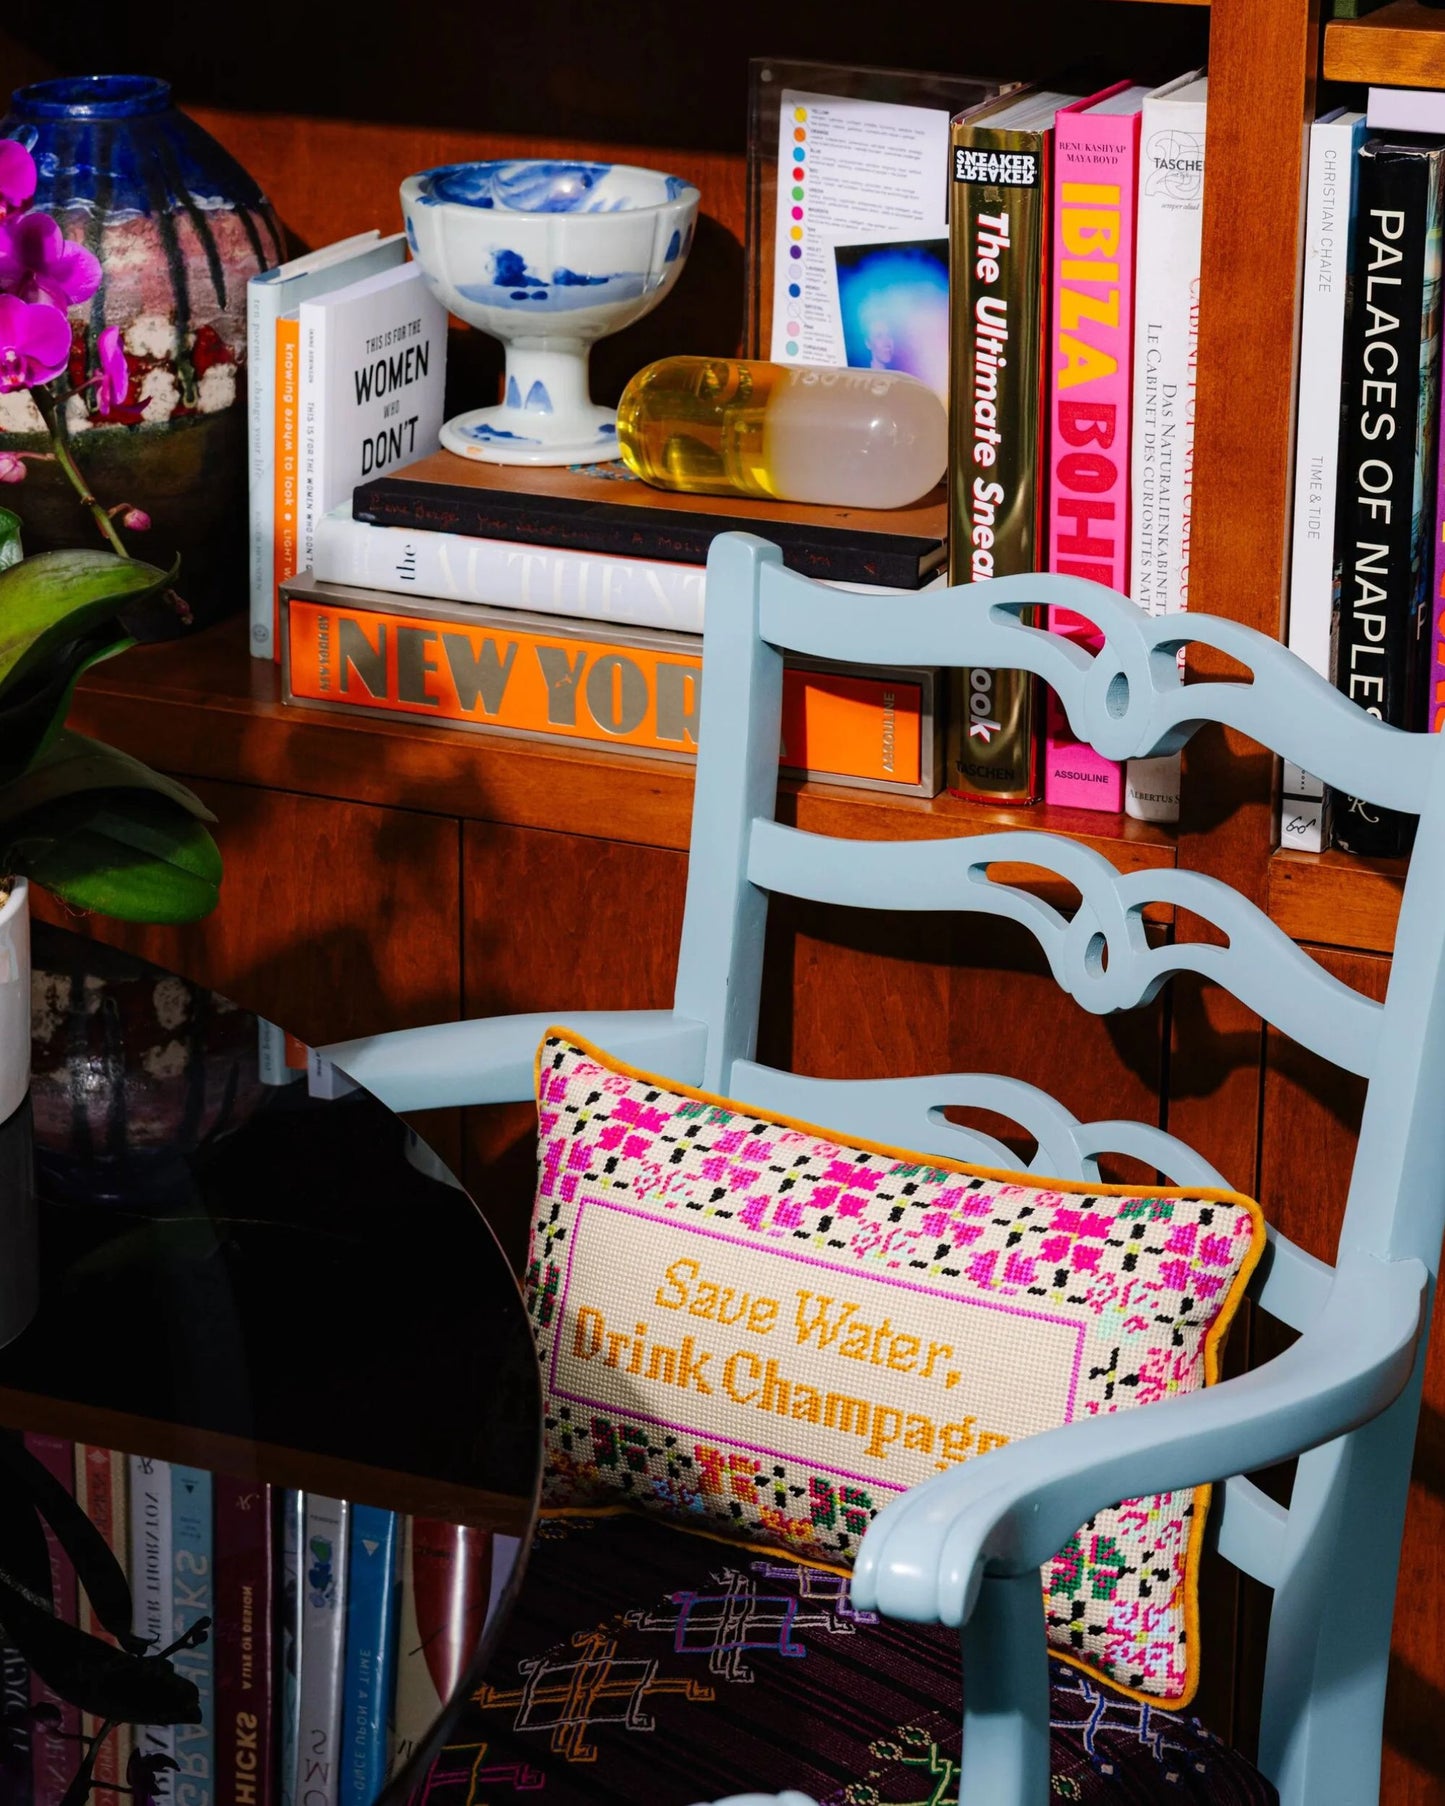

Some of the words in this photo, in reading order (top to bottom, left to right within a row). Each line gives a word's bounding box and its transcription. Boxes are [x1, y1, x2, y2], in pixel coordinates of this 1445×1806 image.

[956, 150, 1035, 168] SNEAKER
[1059, 141, 1083, 151] RENU
[1085, 142, 1127, 154] KASHYAP
[1067, 153, 1092, 163] MAYA
[1093, 155, 1118, 165] BOYD
[1154, 157, 1203, 172] TASCHE
[1322, 149, 1337, 232] CHRISTIAN
[976, 212, 1010, 284] The
[1319, 237, 1333, 292] CHAIZE
[1058, 182, 1121, 390] IBIZA
[366, 334, 383, 354] THIS
[385, 330, 392, 347] IS
[393, 325, 406, 343] FOR
[407, 319, 421, 337] THE
[1148, 323, 1162, 344] LE
[1360, 209, 1405, 440] PALACES
[283, 343, 295, 403] knowing
[355, 340, 429, 406] WOMEN
[973, 295, 1009, 468] Ultimate
[1145, 349, 1161, 428] CABINET
[307, 402, 315, 422] THIS
[383, 399, 400, 418] WHO
[1162, 384, 1177, 418] DAS
[307, 425, 315, 435] IS
[307, 438, 315, 454] FOR
[361, 416, 419, 476] DON'T
[283, 456, 294, 471] to
[1144, 433, 1155, 462] DES
[306, 458, 314, 474] THE
[1310, 456, 1324, 490] TIME
[284, 477, 295, 506] look
[306, 477, 314, 510] WOMEN
[1310, 492, 1322, 504] &
[1357, 459, 1393, 525] OF
[1308, 506, 1320, 539] TIDE
[284, 529, 292, 562] LIGHT
[396, 543, 417, 581] the
[338, 617, 518, 716] NEW
[535, 646, 701, 745] YOR
[969, 667, 1001, 743] ook
[882, 692, 896, 773] ASSOULINE
[956, 761, 1015, 781] TASCHEN
[1055, 770, 1109, 784] ASSOULINE
[1128, 788, 1173, 804] ALBERTUS
[654, 1257, 780, 1335] Save
[796, 1289, 963, 1390] Water,
[571, 1304, 714, 1395] Drink
